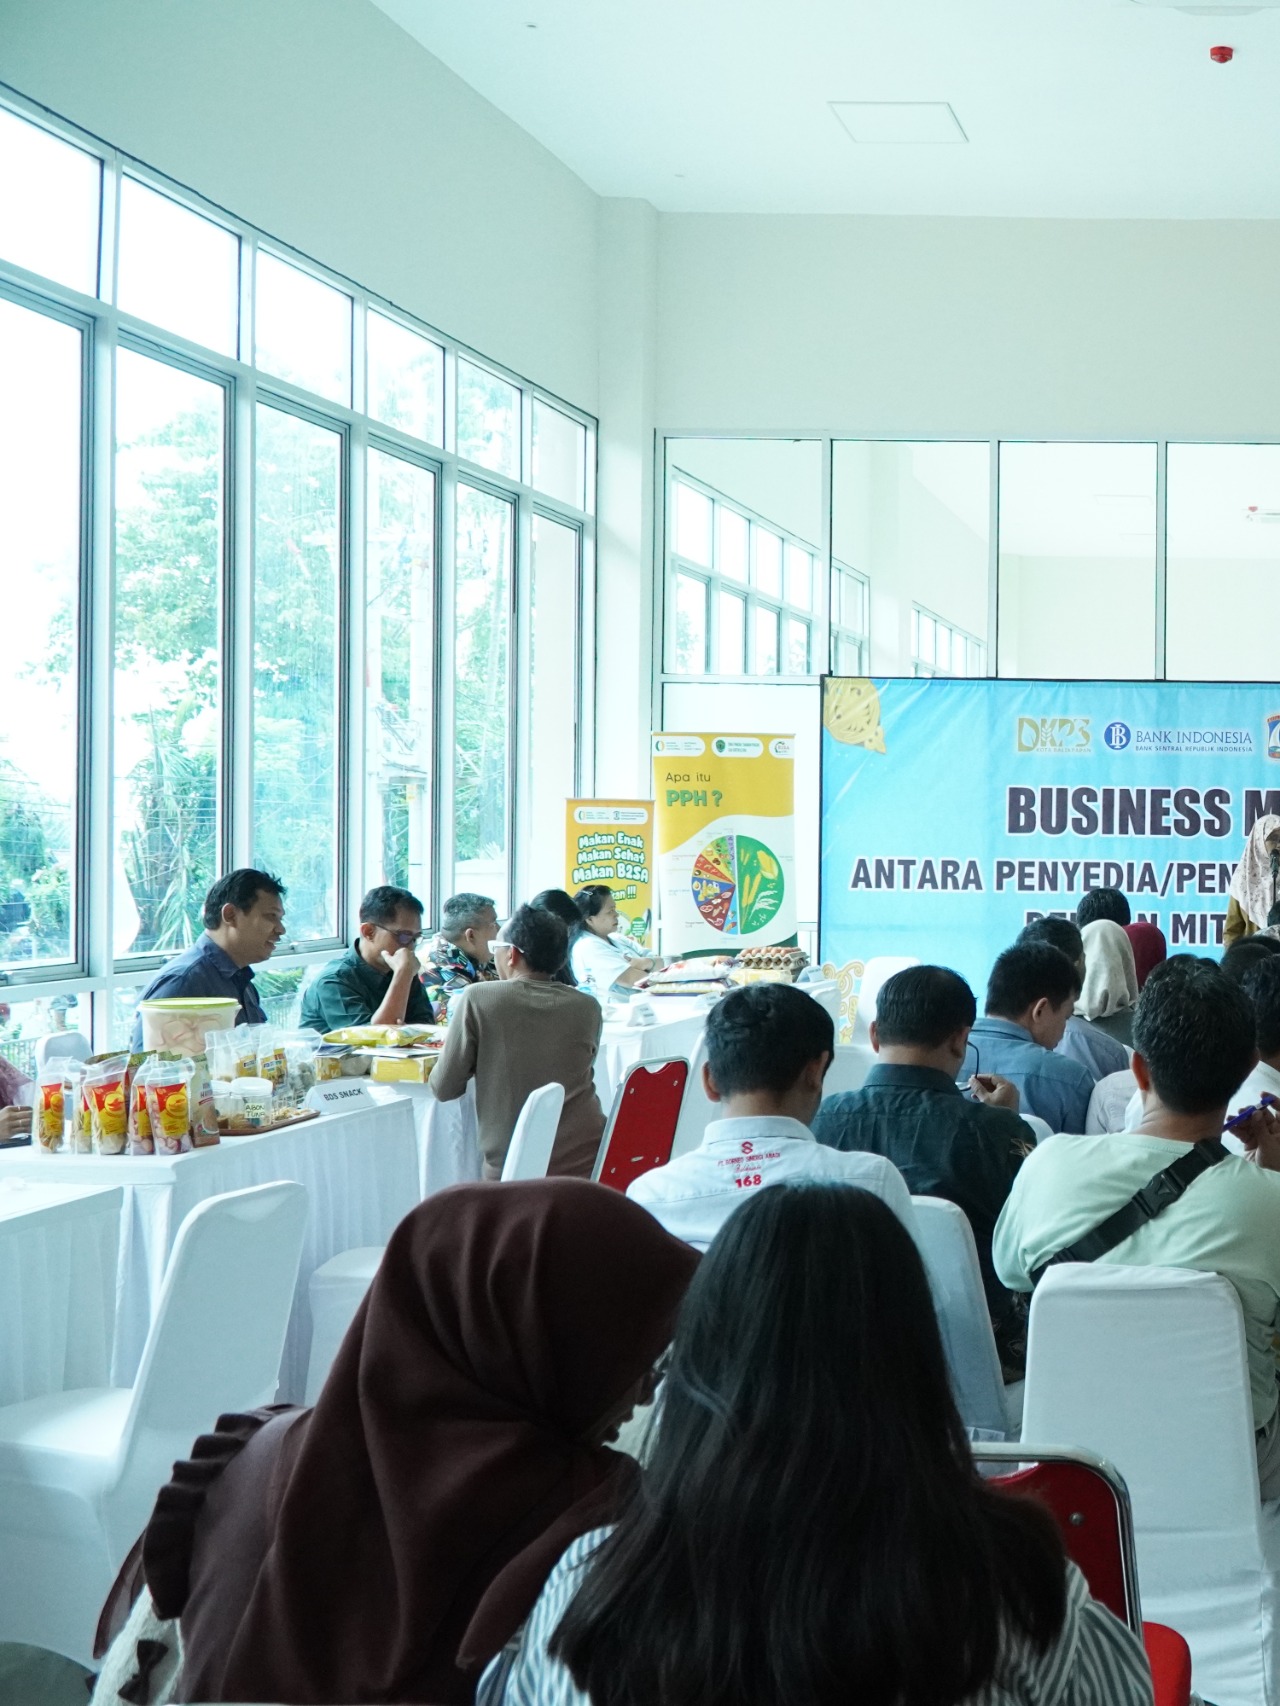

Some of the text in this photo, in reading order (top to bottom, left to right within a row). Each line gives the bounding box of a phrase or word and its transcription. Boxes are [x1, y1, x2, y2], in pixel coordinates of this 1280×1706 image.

[1136, 730, 1253, 744] BANK INDONESIA
[666, 772, 710, 783] Apa itu
[666, 790, 708, 806] PPH
[1008, 787, 1231, 837] BUSINESS
[578, 831, 644, 850] Makan Enak
[577, 846, 645, 865] Makan Sehat
[572, 862, 648, 884] Makan B2SA
[851, 858, 983, 890] ANTARA
[1172, 914, 1226, 944] MIT
[323, 1088, 363, 1101] BDS SNACK
[735, 1174, 761, 1188] 168
